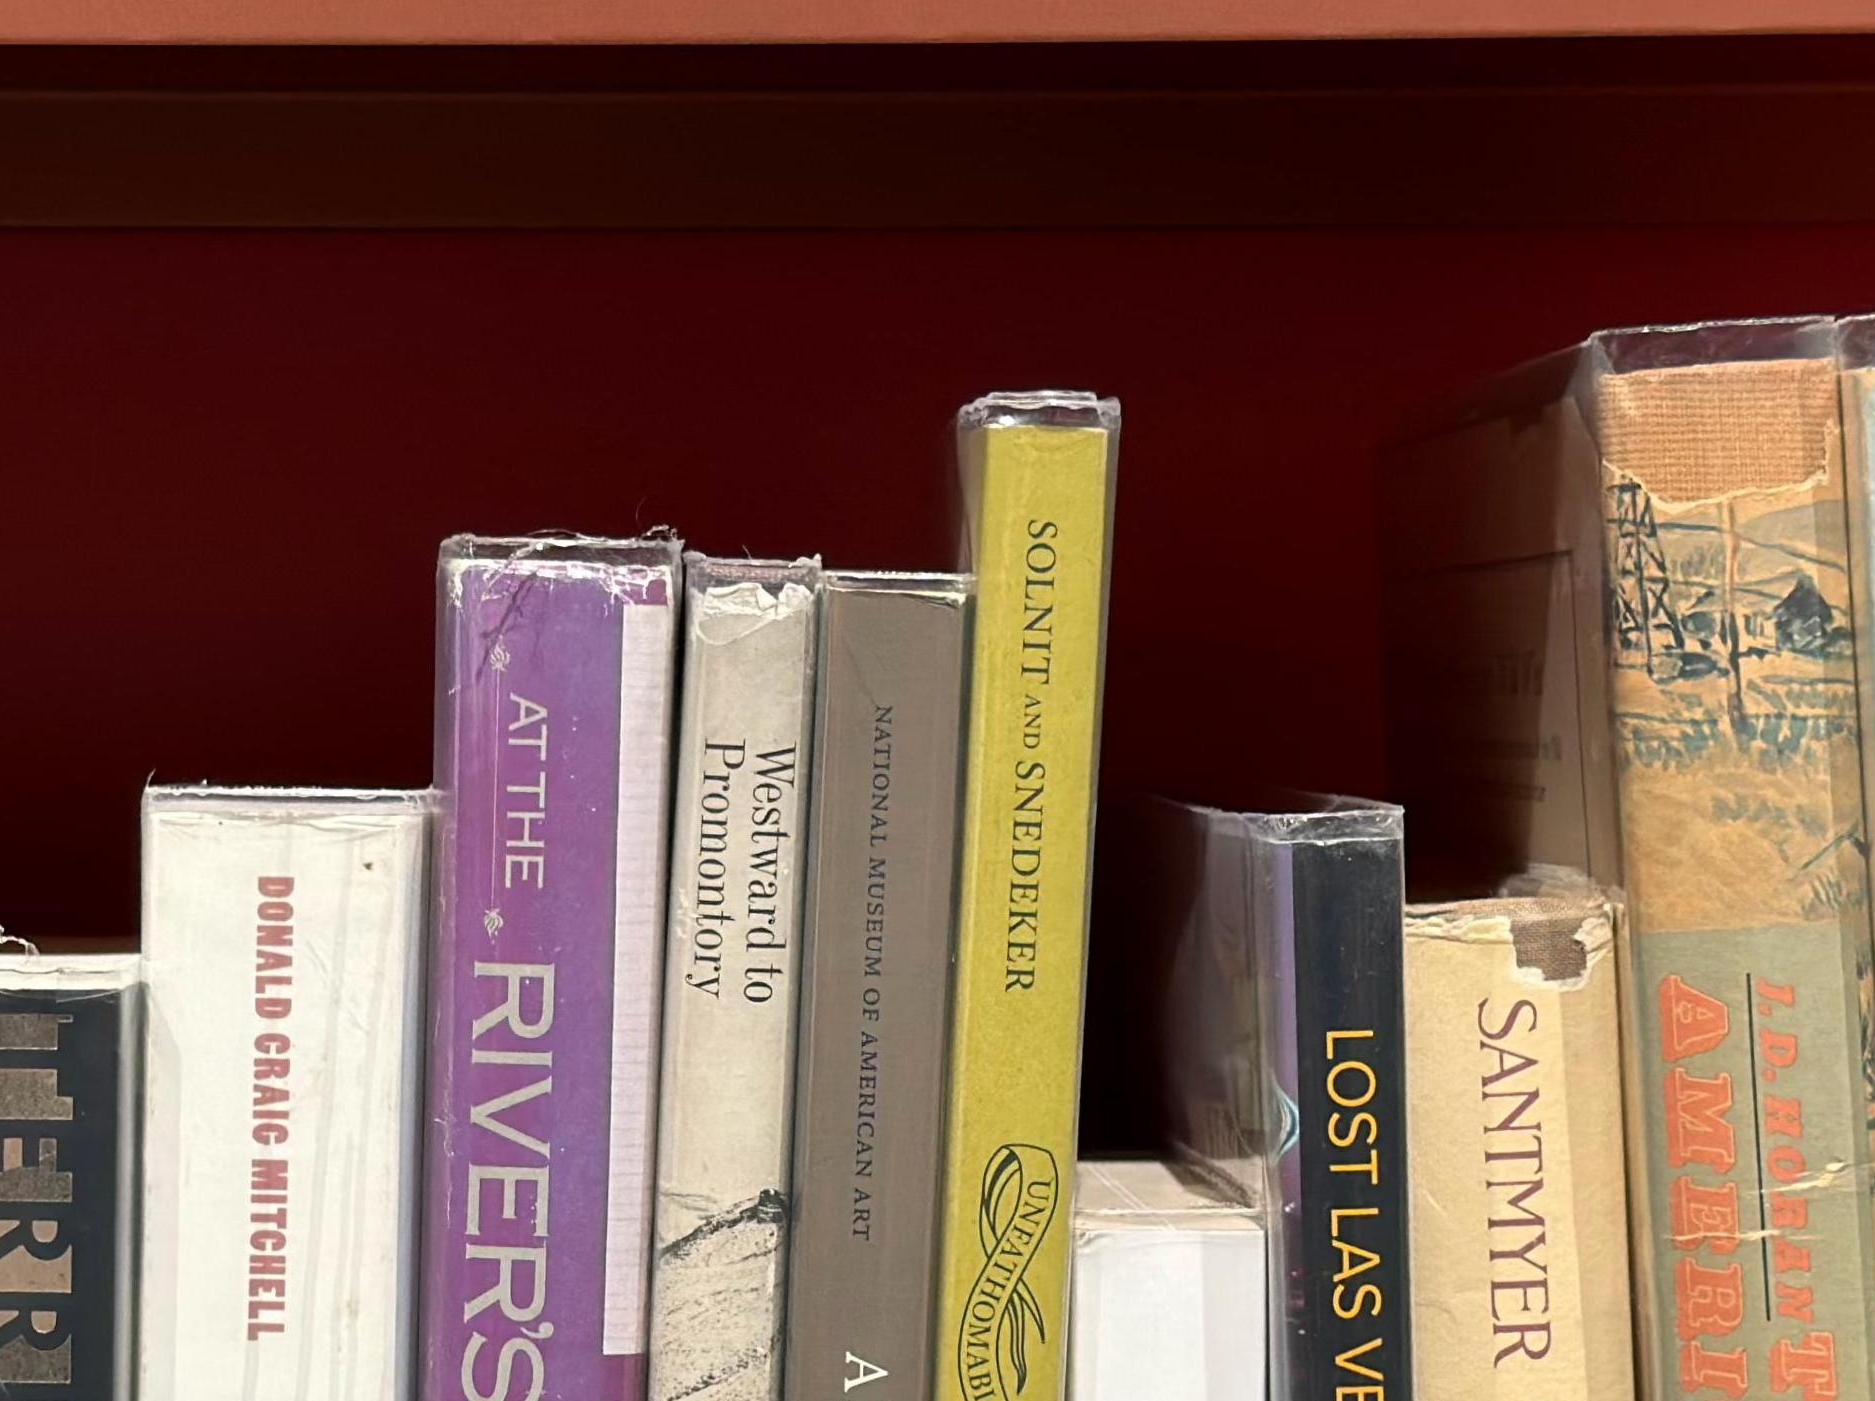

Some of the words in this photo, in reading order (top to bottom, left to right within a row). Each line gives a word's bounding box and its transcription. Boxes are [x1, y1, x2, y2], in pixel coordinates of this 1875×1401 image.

[1021, 518, 1059, 685] SOLNIT
[507, 692, 548, 764] AT
[867, 705, 894, 848] NATIONAL
[1022, 693, 1040, 749] AND
[504, 771, 547, 890] THE
[684, 737, 746, 1000] Promontory
[745, 741, 797, 953] Westward
[1005, 761, 1046, 993] SNEDEKER
[254, 875, 296, 1020] DONALD
[743, 960, 777, 1004] to
[864, 857, 888, 978] MUSEUM
[862, 986, 881, 1022] OF
[1759, 1028, 1798, 1083] D.
[250, 1031, 293, 1146] CRAIG
[853, 1028, 880, 1179] AMERICAN
[1324, 1029, 1379, 1184] LOST
[246, 1158, 291, 1343] MITCHELL
[851, 1189, 871, 1242] ART
[1476, 997, 1551, 1371] SANTMYER
[1764, 1097, 1814, 1325] HORAN
[1331, 1206, 1382, 1320] LAS
